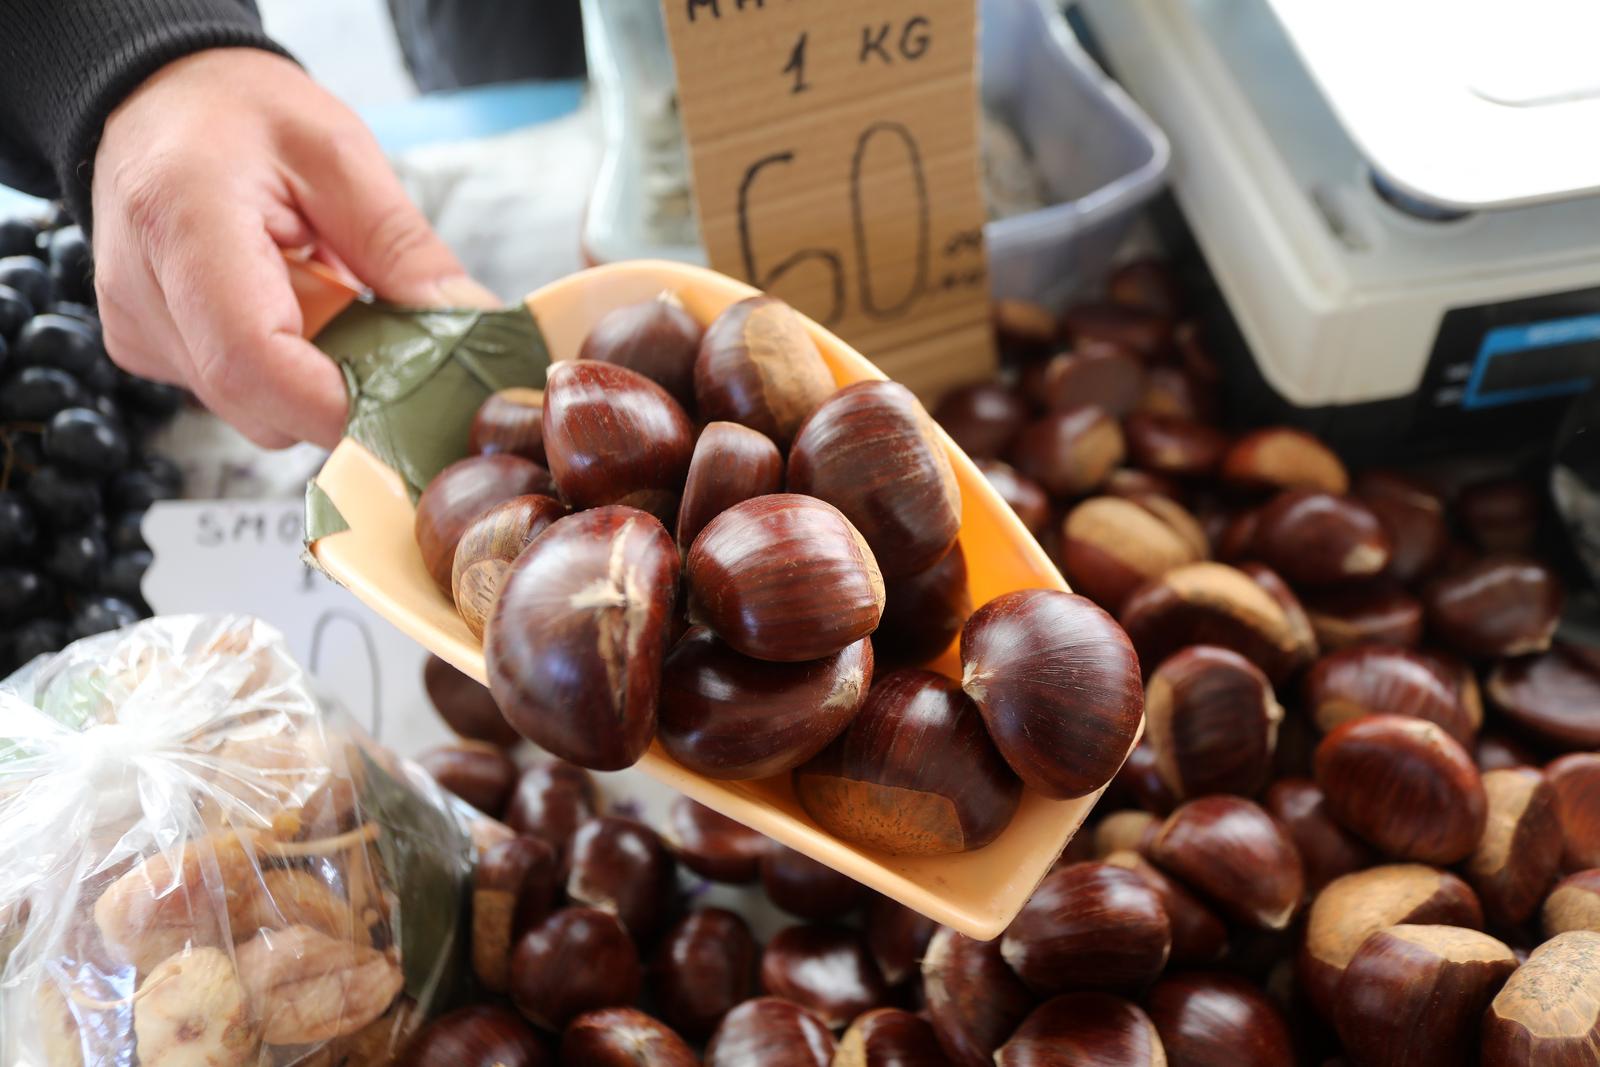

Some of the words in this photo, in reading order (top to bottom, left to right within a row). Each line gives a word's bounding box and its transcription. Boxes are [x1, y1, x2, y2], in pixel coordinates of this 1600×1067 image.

[782, 31, 811, 94] 1
[858, 16, 930, 63] KG
[737, 120, 930, 328] 60
[196, 512, 303, 547] SMO
